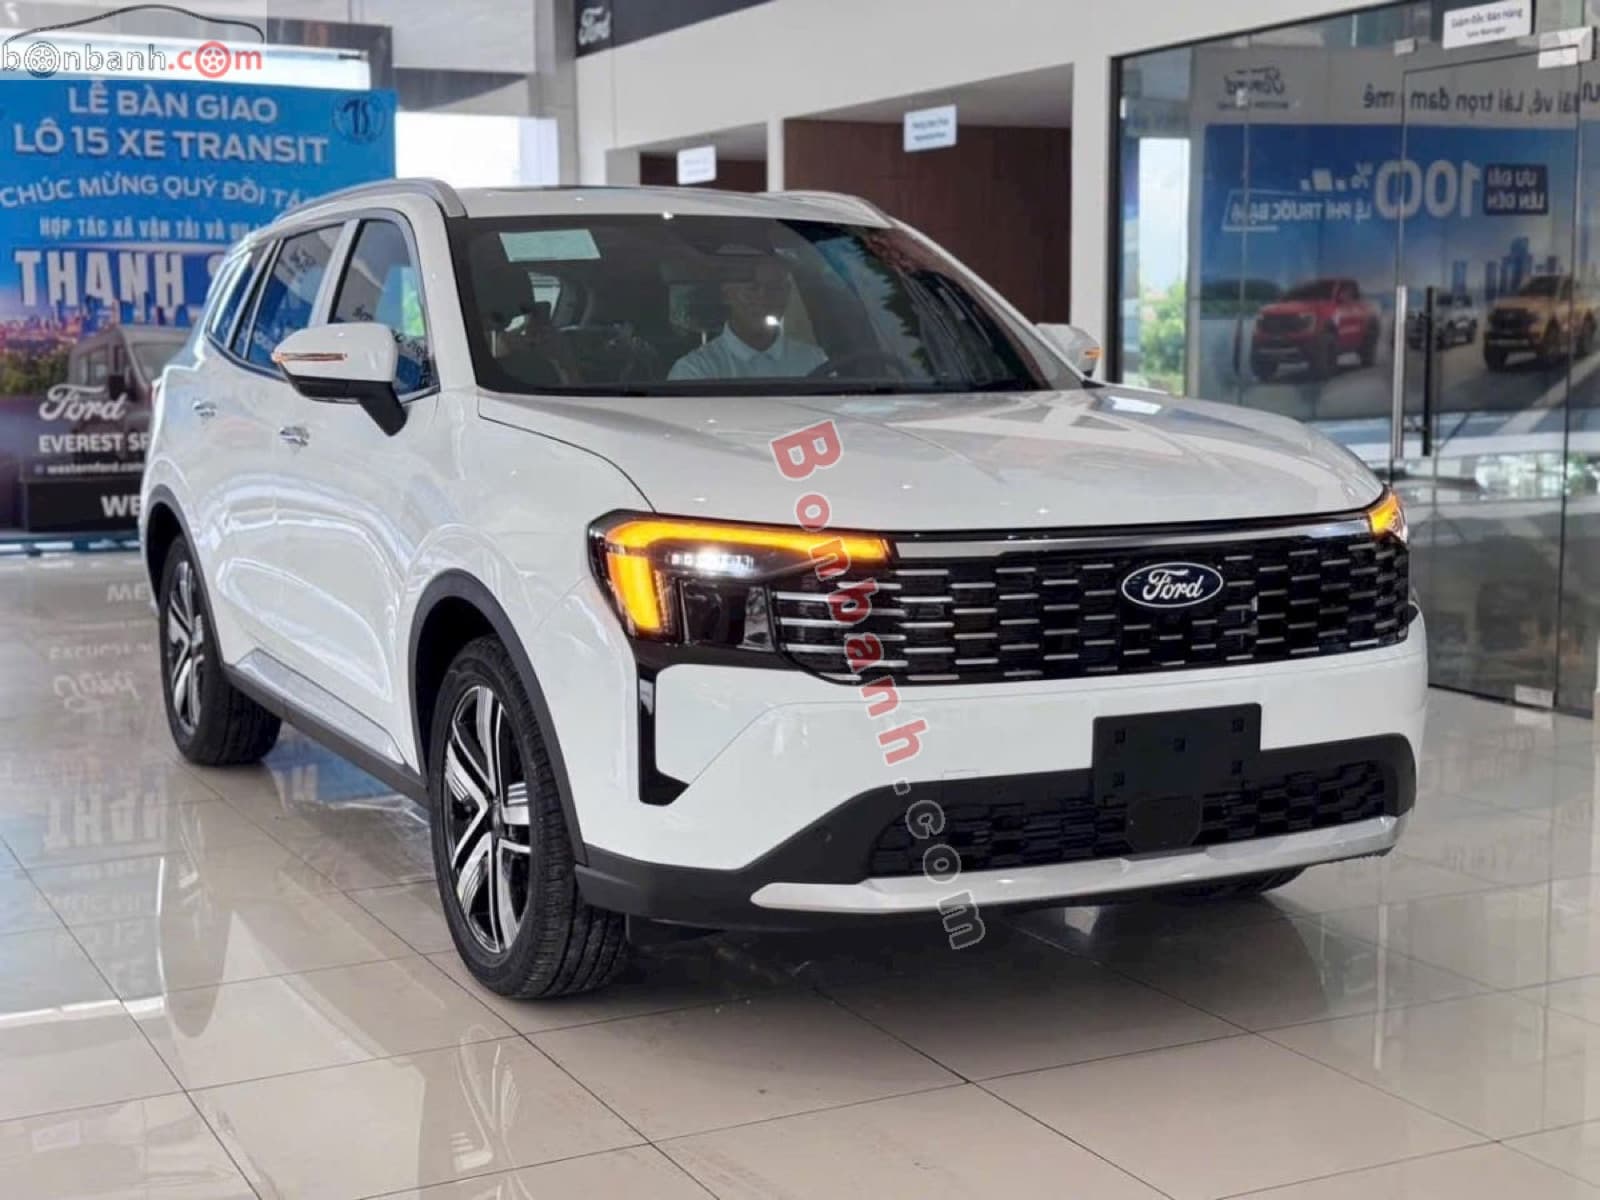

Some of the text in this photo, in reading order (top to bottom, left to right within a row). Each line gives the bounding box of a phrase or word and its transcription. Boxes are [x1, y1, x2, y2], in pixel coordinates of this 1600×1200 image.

[117, 85, 189, 119] BÀN
[196, 94, 278, 124] GIAO
[12, 118, 329, 165] LÔ 15 XE TRANSIT
[0, 176, 74, 208] CHÚC
[78, 171, 159, 198] MỪNG
[163, 174, 217, 200] QUÝ
[272, 186, 304, 211] TÁ
[15, 250, 185, 306] THANH
[39, 384, 128, 420] Ford
[39, 434, 123, 453] EVEREST
[101, 495, 142, 517] WE
[1143, 568, 1204, 601] Ford
